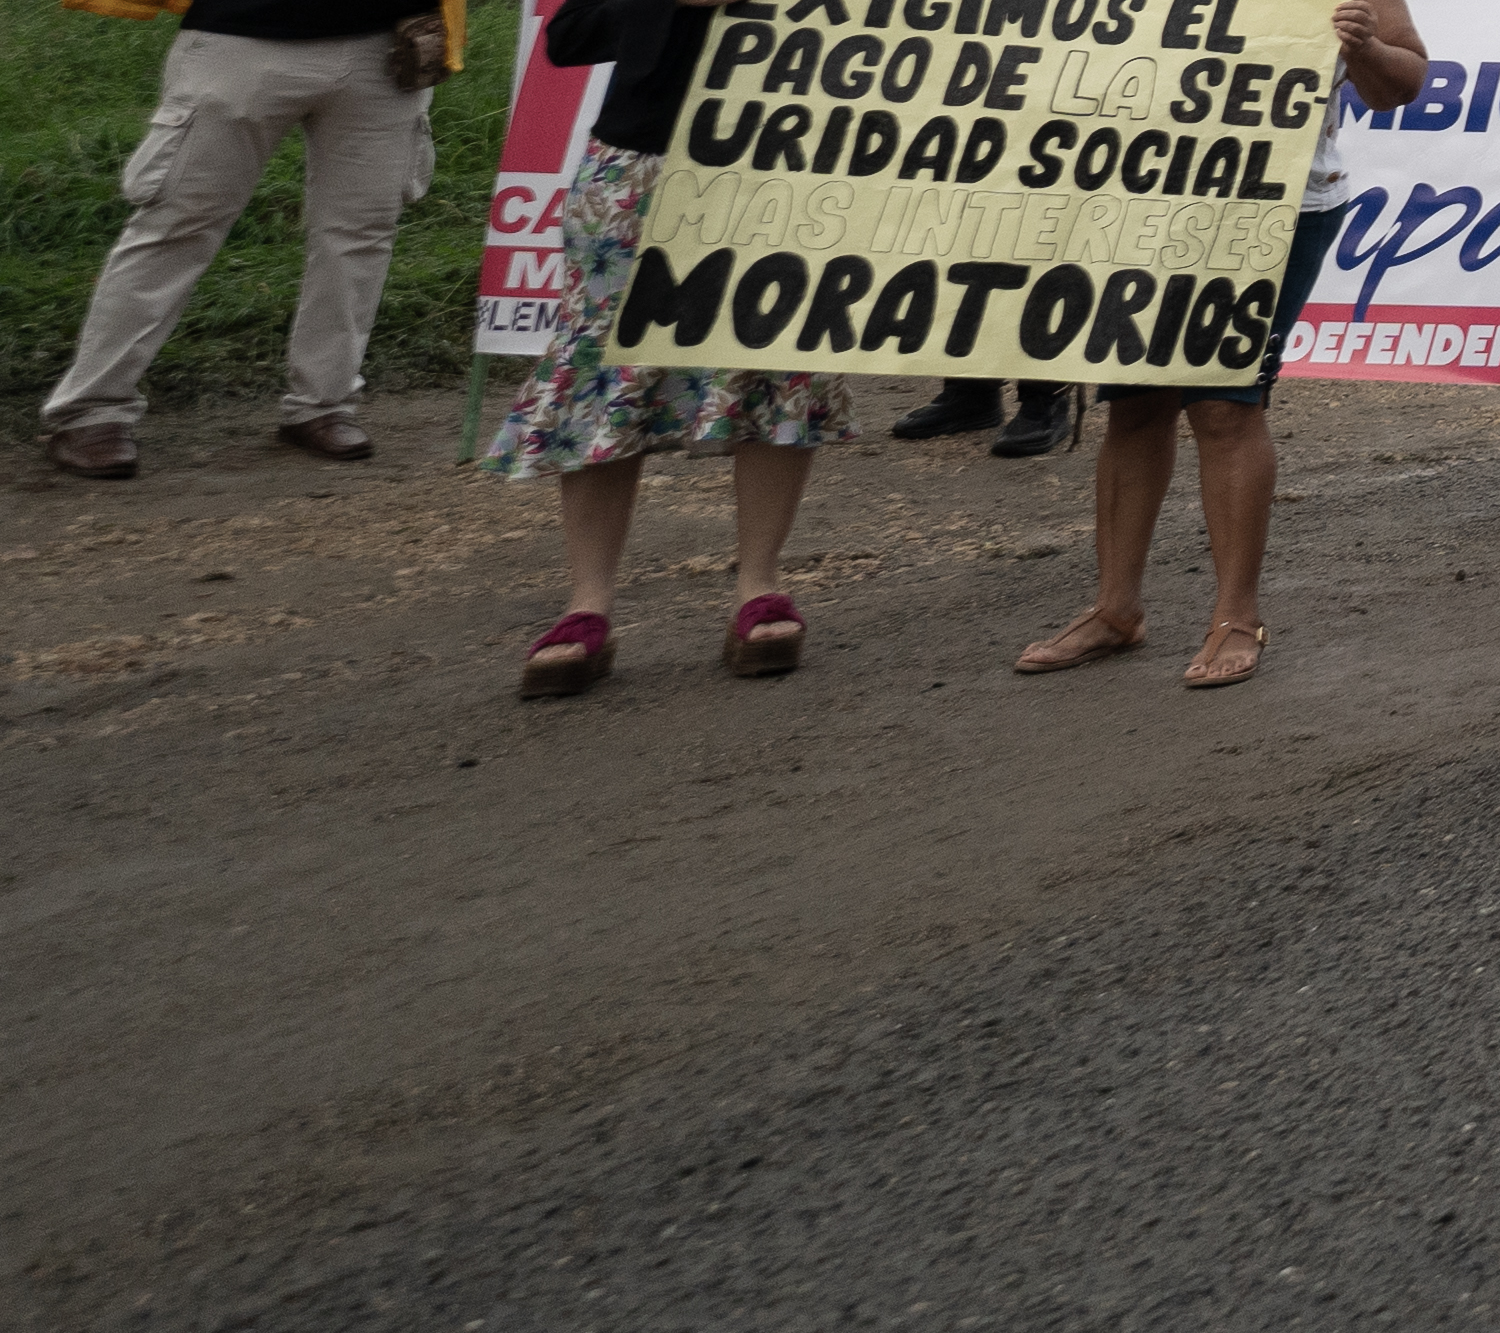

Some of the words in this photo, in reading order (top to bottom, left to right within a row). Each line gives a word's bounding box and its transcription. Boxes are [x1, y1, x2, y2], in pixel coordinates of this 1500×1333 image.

[704, 21, 933, 104] PAGO
[943, 40, 1042, 111] DE
[1050, 49, 1157, 120] LA
[687, 97, 1007, 184] URIDAD
[1018, 126, 1286, 200] SOCIAL
[650, 169, 852, 250] MAS
[870, 185, 1297, 274] INTERESES
[615, 245, 1276, 371] MORATORIOS
